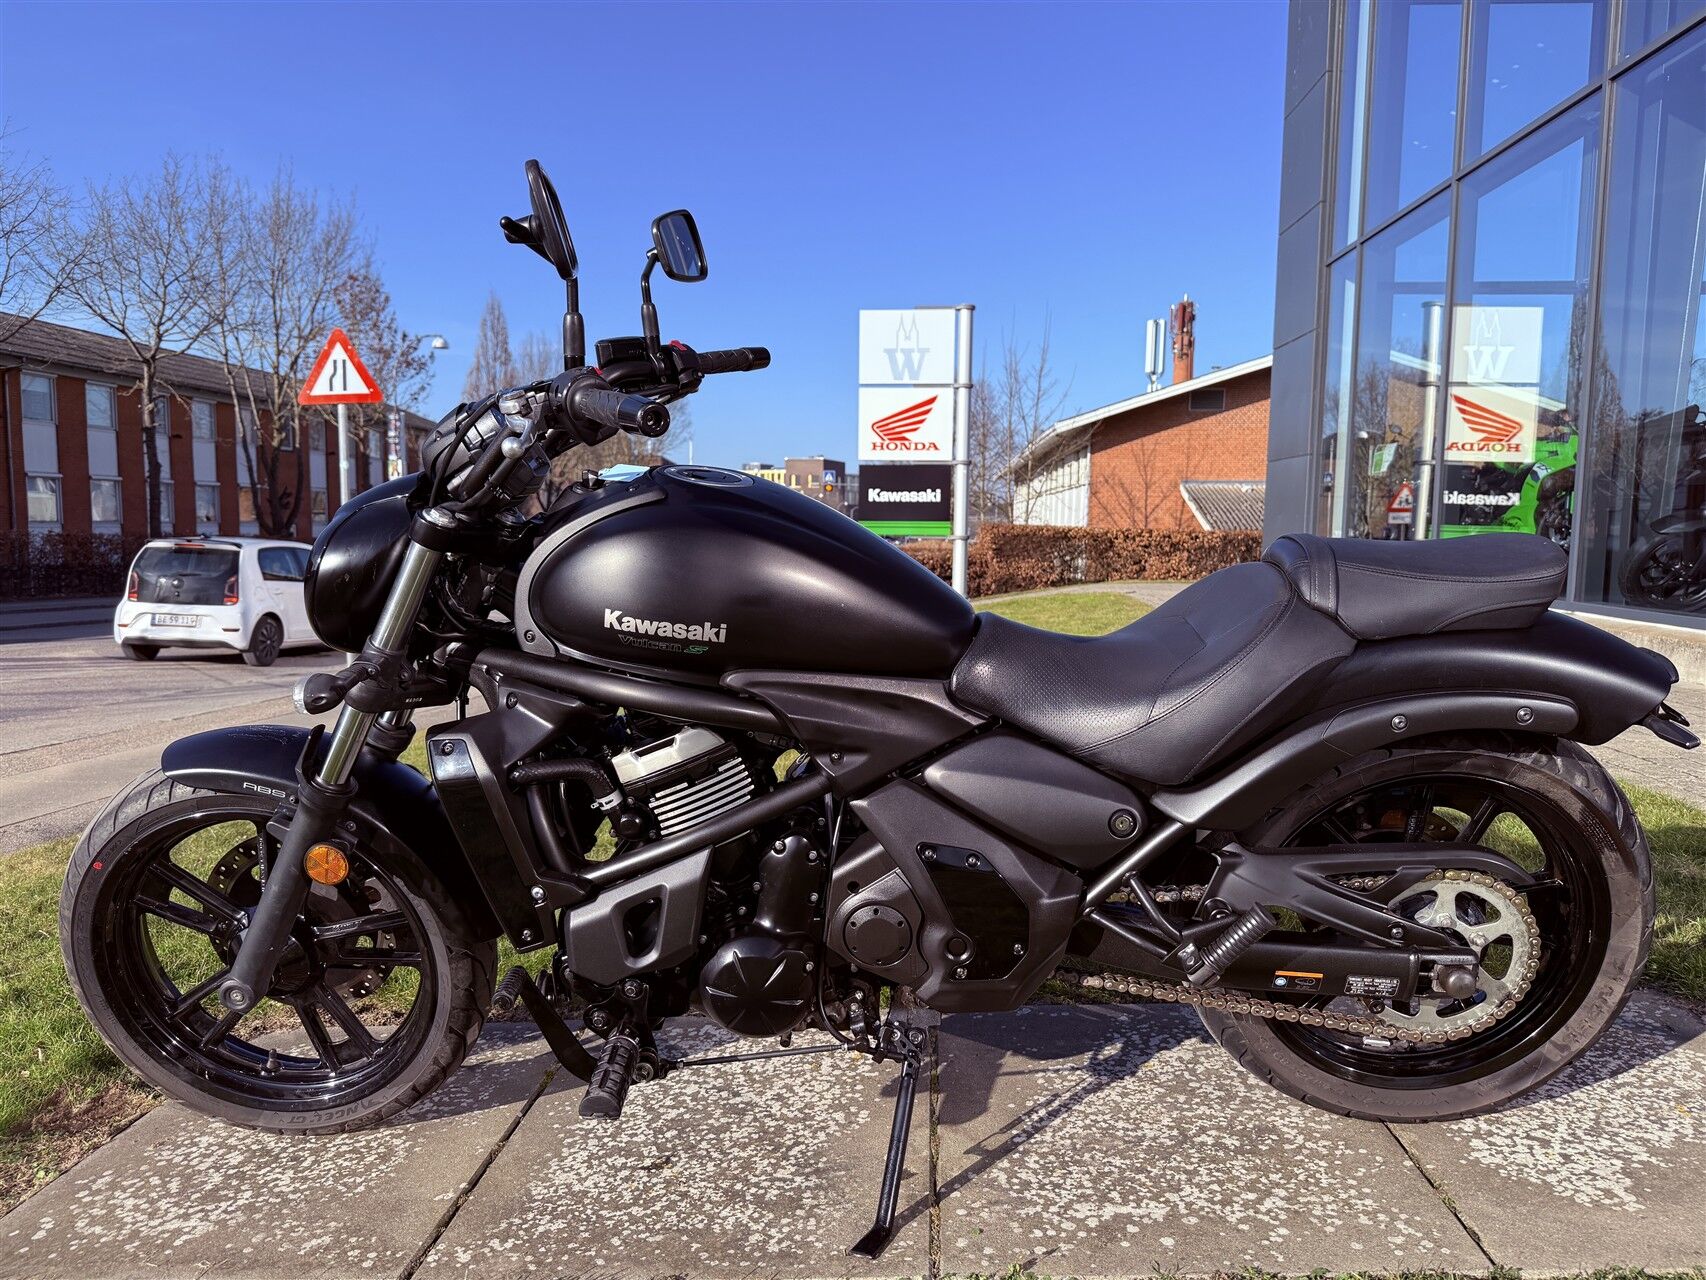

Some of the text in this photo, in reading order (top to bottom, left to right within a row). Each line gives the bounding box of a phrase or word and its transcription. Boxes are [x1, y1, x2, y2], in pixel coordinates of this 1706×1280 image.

[884, 348, 930, 381] W
[871, 441, 940, 451] HONDA
[868, 488, 942, 503] Kawasaki
[604, 608, 728, 643] Kawasaki
[618, 634, 709, 655] Vulcan S
[243, 782, 286, 798] ABS
